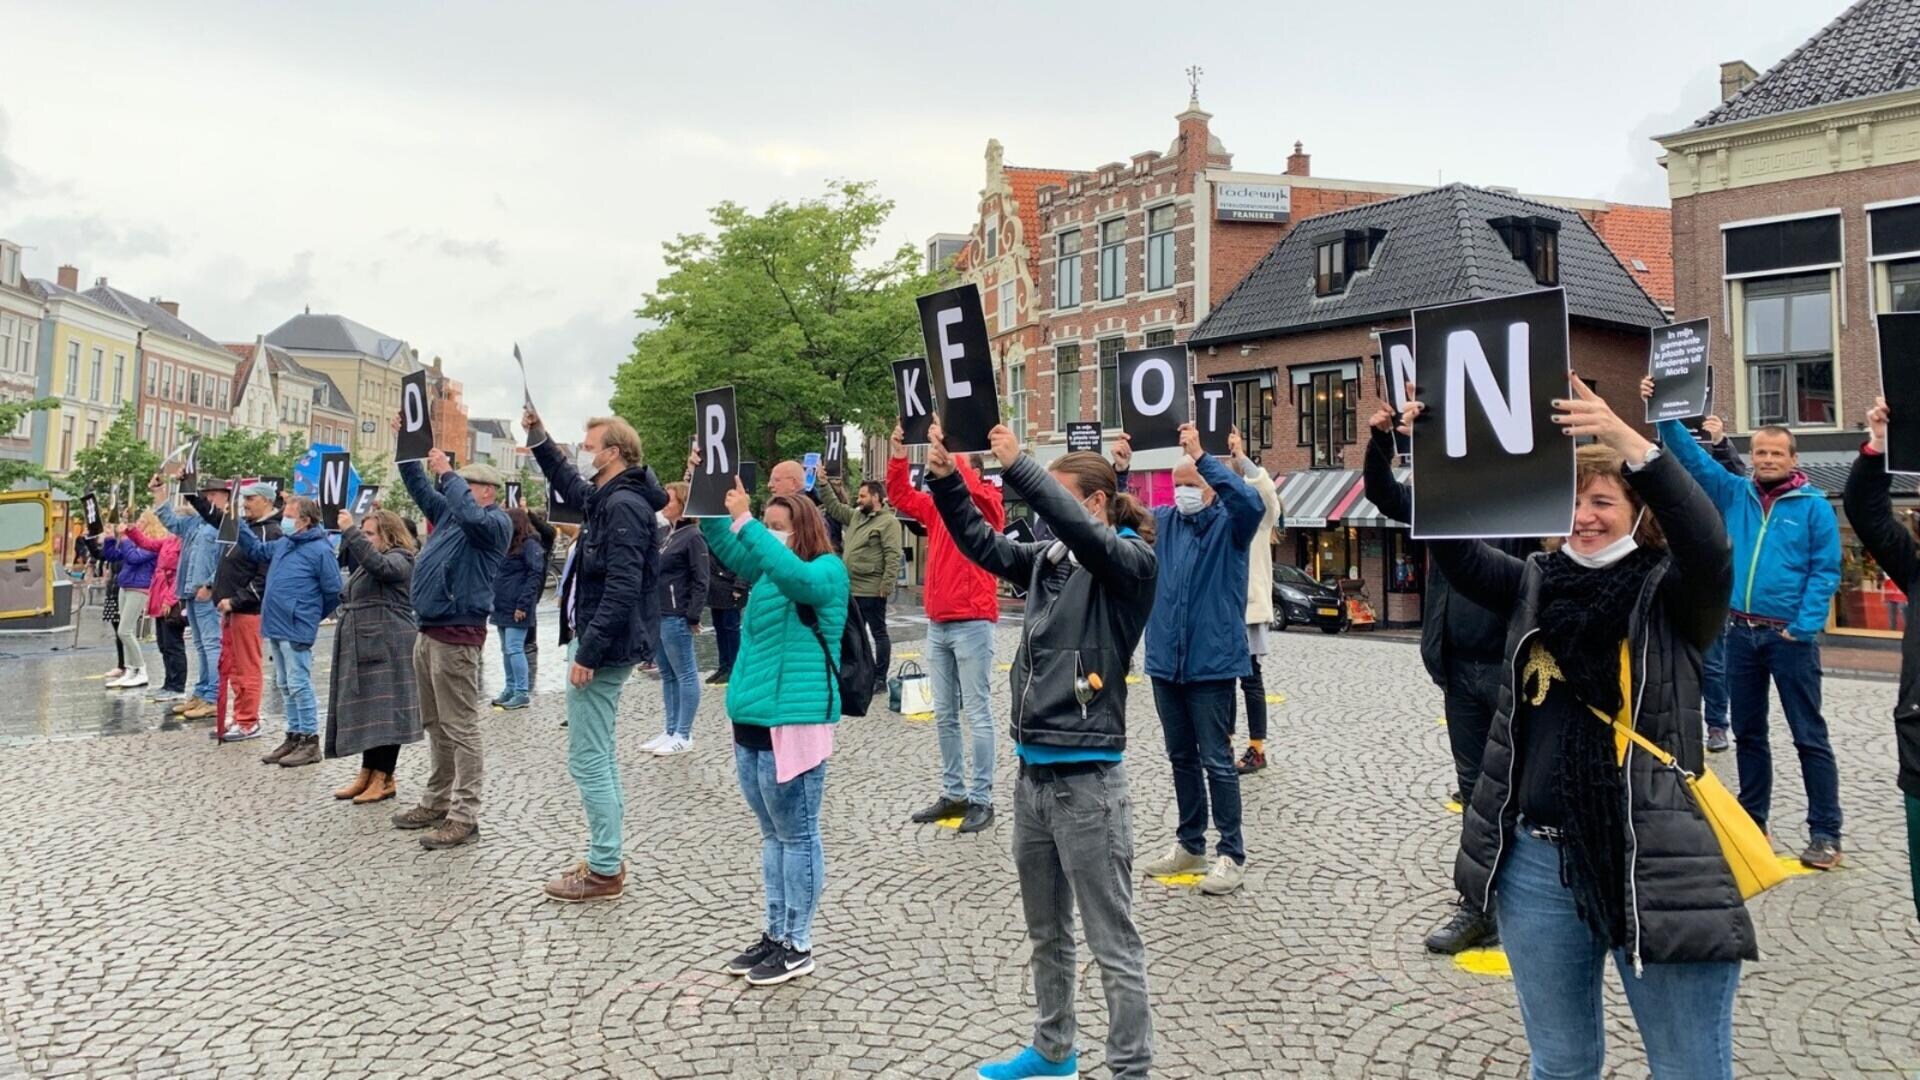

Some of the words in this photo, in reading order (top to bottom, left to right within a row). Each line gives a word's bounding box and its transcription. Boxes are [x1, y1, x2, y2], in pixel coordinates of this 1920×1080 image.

[1232, 211, 1275, 220] FRANEKER
[1660, 336, 1701, 351] gemeente
[1667, 331, 1675, 340] In
[1677, 328, 1694, 338] mijn
[937, 306, 972, 400] E
[1655, 357, 1690, 369] kinderen
[1691, 354, 1702, 363] uit
[1661, 348, 1685, 361] plaats
[1686, 346, 1705, 355] voor
[1131, 358, 1175, 416] O
[1665, 367, 1689, 377] Moria
[902, 367, 926, 417] K
[1446, 320, 1534, 459] N
[404, 382, 423, 433] D
[1203, 389, 1224, 433] T
[704, 404, 729, 475] R
[827, 431, 840, 461] H
[324, 461, 344, 505] N
[508, 485, 519, 508] K
[355, 489, 373, 514] E
